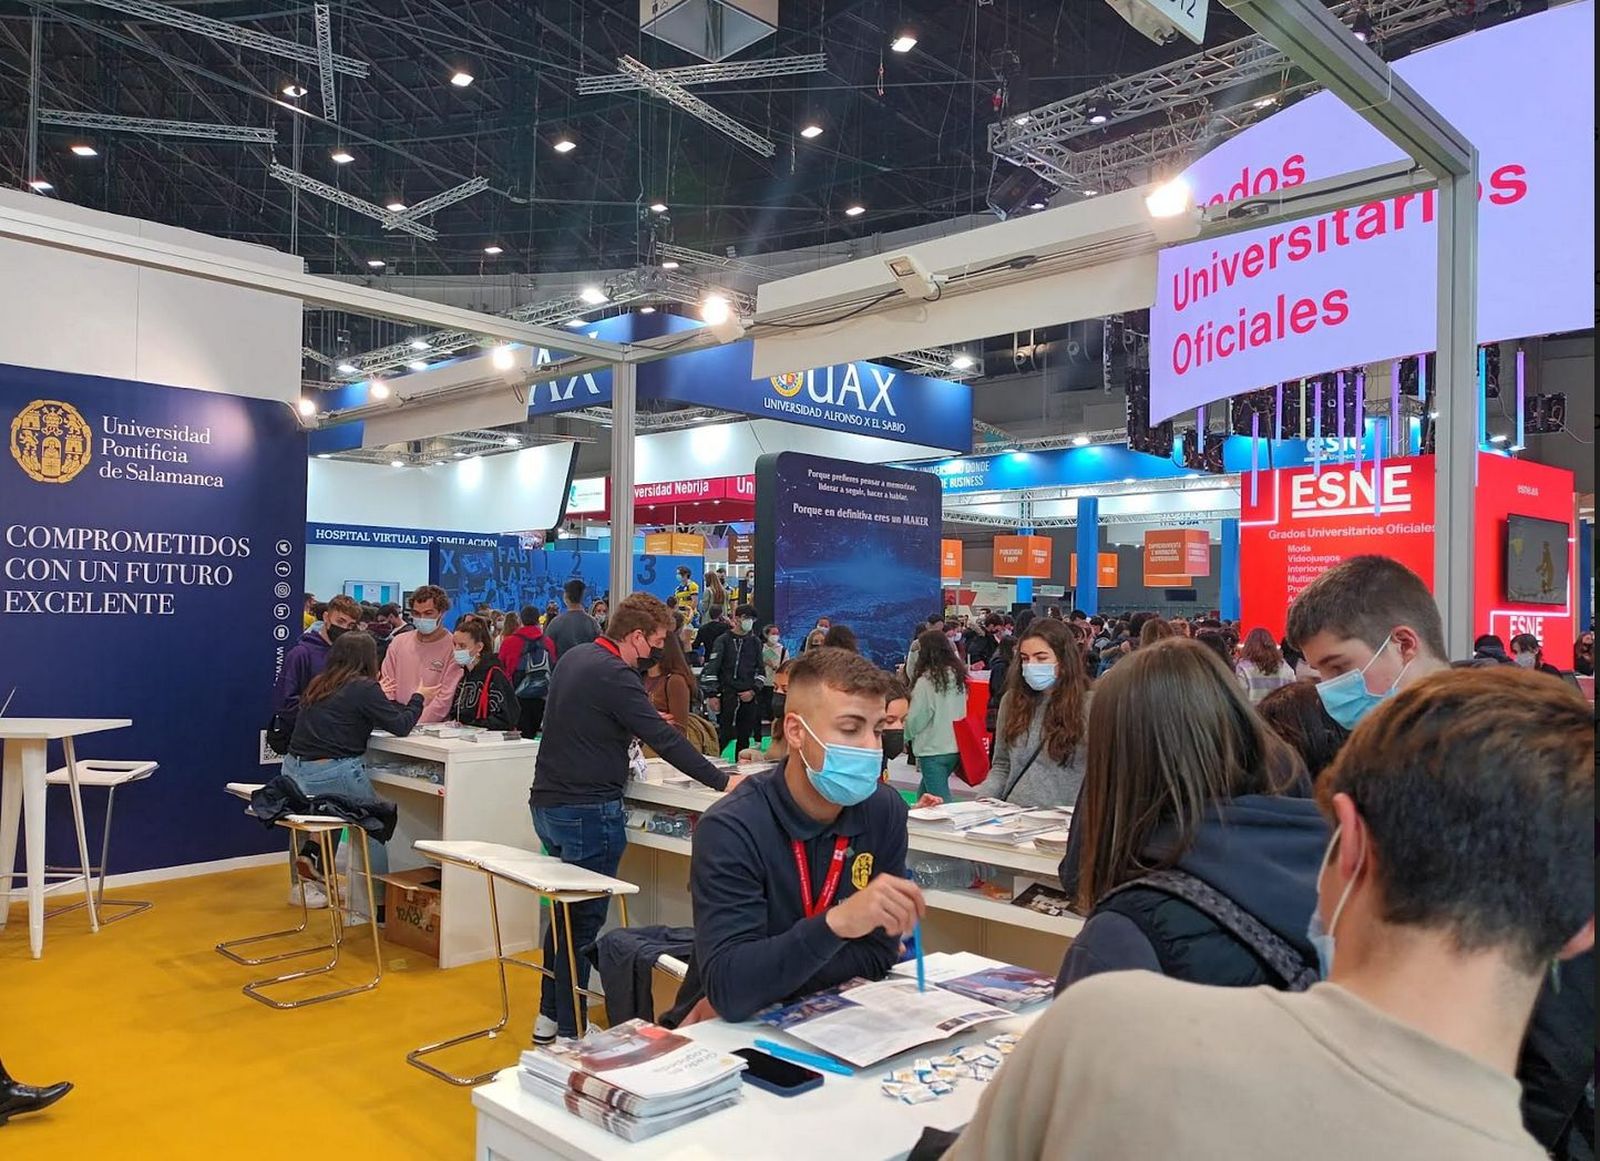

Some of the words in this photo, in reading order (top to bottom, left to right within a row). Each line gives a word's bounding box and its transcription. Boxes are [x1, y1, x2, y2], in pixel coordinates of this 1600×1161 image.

[1173, 163, 1529, 313] Universitaris
[1172, 288, 1350, 376] Oficiales
[806, 362, 897, 417] UAX
[763, 397, 822, 418] UNIVERSIDAD
[823, 410, 863, 426] ALFONSO
[863, 416, 872, 428] X
[871, 418, 881, 429] EL
[881, 420, 906, 434] SABIO
[102, 415, 211, 445] Universidad
[100, 437, 189, 464] Pontificia
[99, 461, 123, 479] de
[125, 462, 225, 488] Salamanca
[736, 476, 755, 494] Un
[949, 475, 984, 489] BUSINESS
[1291, 465, 1412, 510] ESNE
[634, 483, 673, 498] versidad
[674, 480, 709, 496] Nebrija
[793, 502, 823, 517] Porque
[824, 507, 835, 517] en
[836, 507, 873, 521] definitiva
[873, 513, 890, 523] eres
[891, 515, 902, 524] un
[902, 514, 929, 527] MAKER
[5, 524, 250, 558] COMPROMETIDOS
[315, 529, 371, 542] HOSPITAL
[372, 532, 419, 545] VIRTUAL
[1268, 529, 1306, 540] Grados
[1307, 525, 1384, 538] Universitarios
[1287, 544, 1312, 553] Moda
[4, 557, 72, 582] CON
[78, 559, 120, 583] UN
[125, 561, 233, 587] FUTURO
[636, 554, 657, 585] 3
[3, 589, 175, 615] EXCELENTE
[1510, 616, 1544, 641] ESNE
